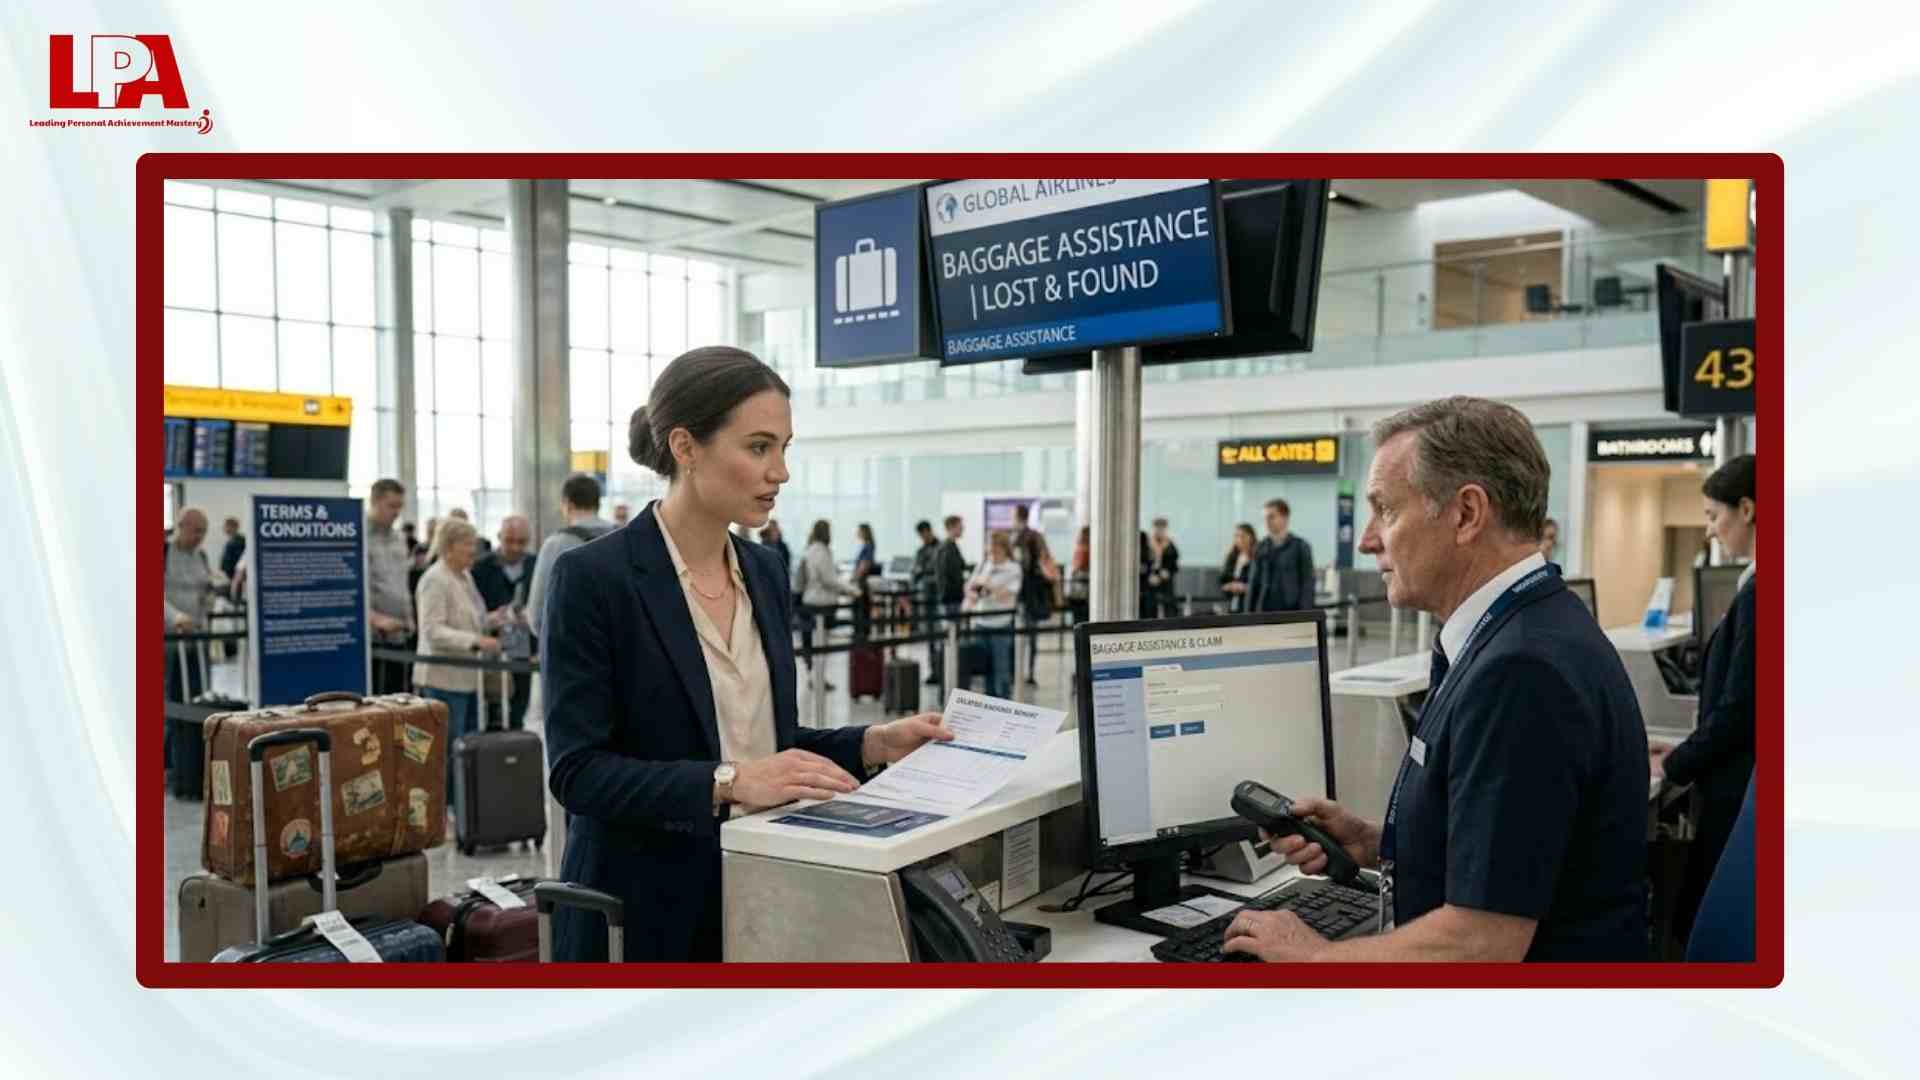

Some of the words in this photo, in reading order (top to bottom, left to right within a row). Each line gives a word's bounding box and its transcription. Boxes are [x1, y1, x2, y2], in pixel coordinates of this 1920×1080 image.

[963, 187, 1032, 213] GLOBAL
[943, 236, 1050, 279] BAGGAGE
[1056, 207, 1209, 260] ASSISTANCE
[983, 277, 1038, 310] LOST
[1044, 275, 1062, 302] &
[1068, 259, 1159, 298] FOUND
[948, 335, 1003, 354] BAGGAGE
[1004, 325, 1076, 347] ASSISTANCE
[1694, 347, 1755, 389] 43
[1239, 445, 1265, 462] ALL
[1266, 442, 1314, 461] GATES
[260, 504, 313, 520] TERMS
[315, 504, 328, 519] &
[260, 522, 357, 538] CONDITIONS
[1091, 640, 1136, 655] BAGGAGE
[1137, 637, 1187, 651] ASSISTANCE
[1197, 635, 1223, 649] CLAIM
